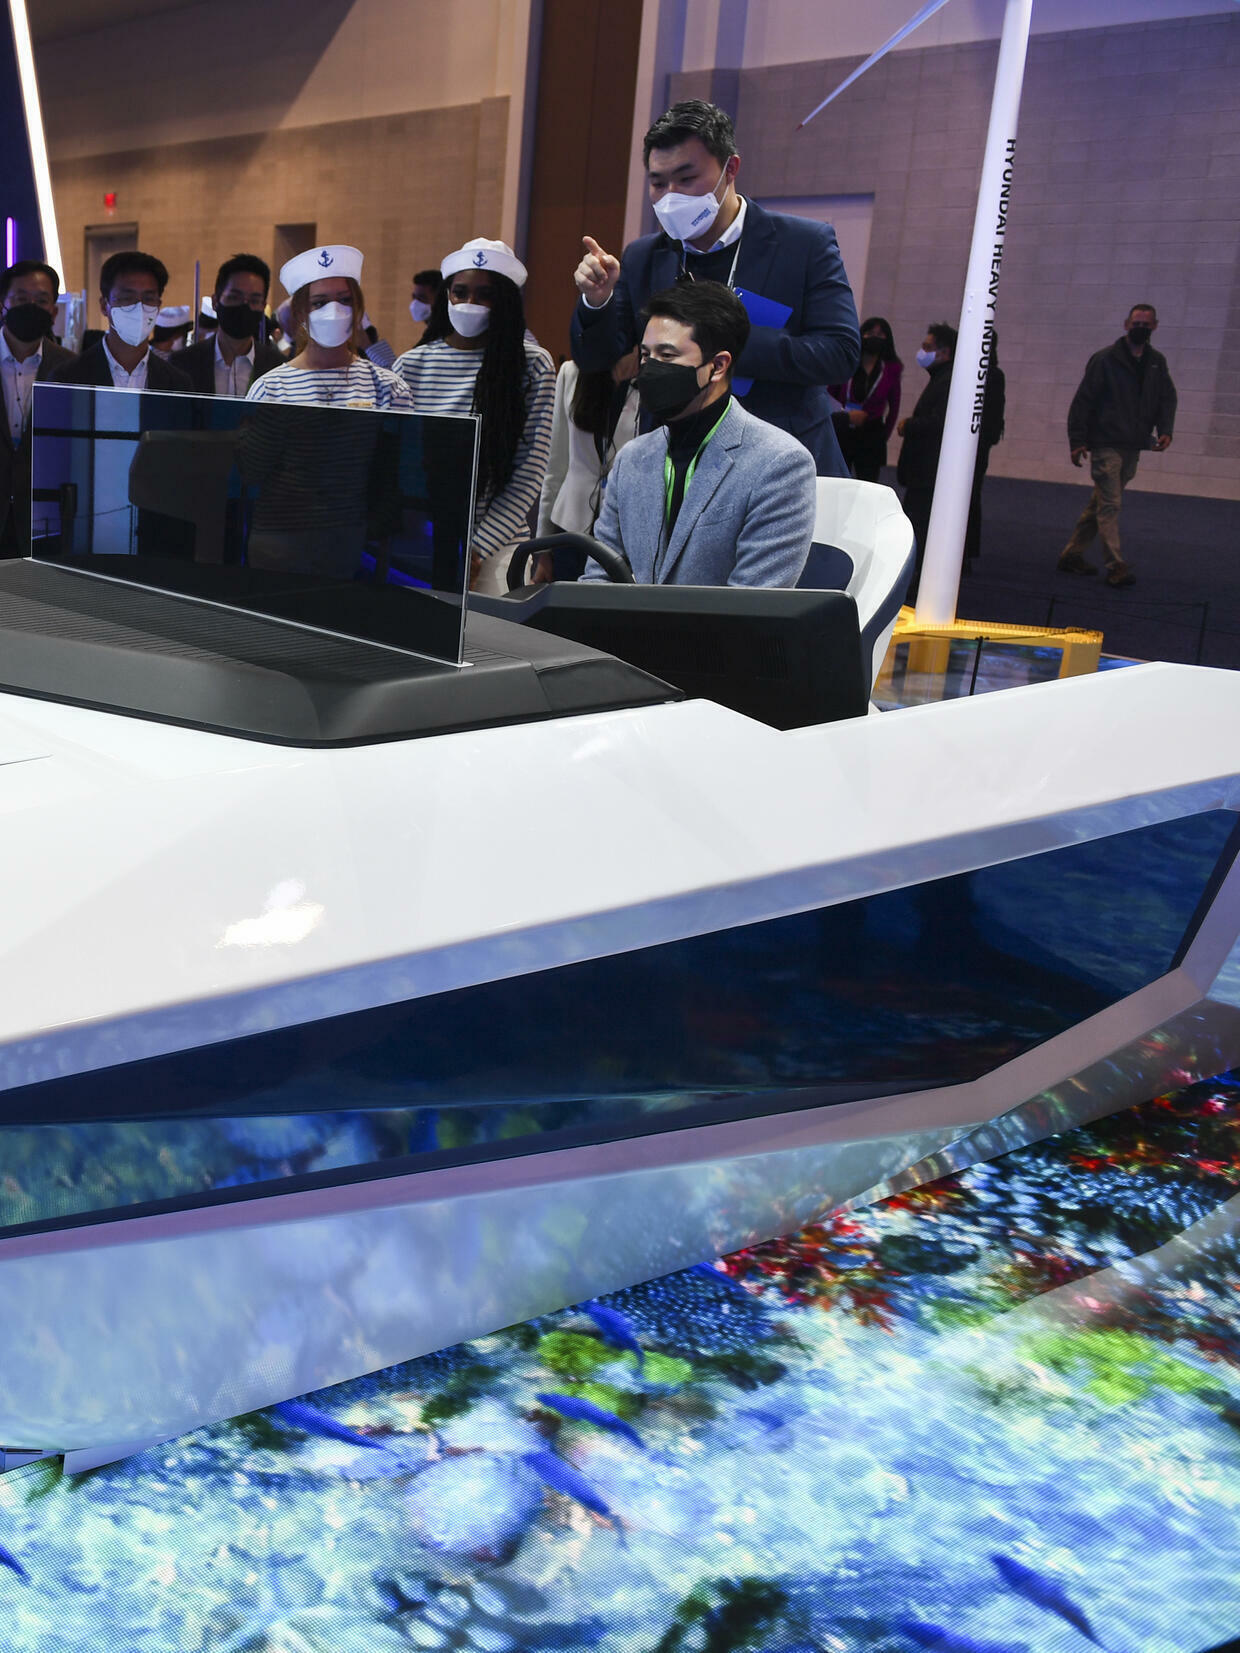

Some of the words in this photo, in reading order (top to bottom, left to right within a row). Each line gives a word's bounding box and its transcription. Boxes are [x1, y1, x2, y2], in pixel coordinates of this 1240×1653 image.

[996, 138, 1016, 236] HYUNDAI
[986, 244, 1004, 312] HEAVY
[970, 319, 994, 435] INDUSTRIES
